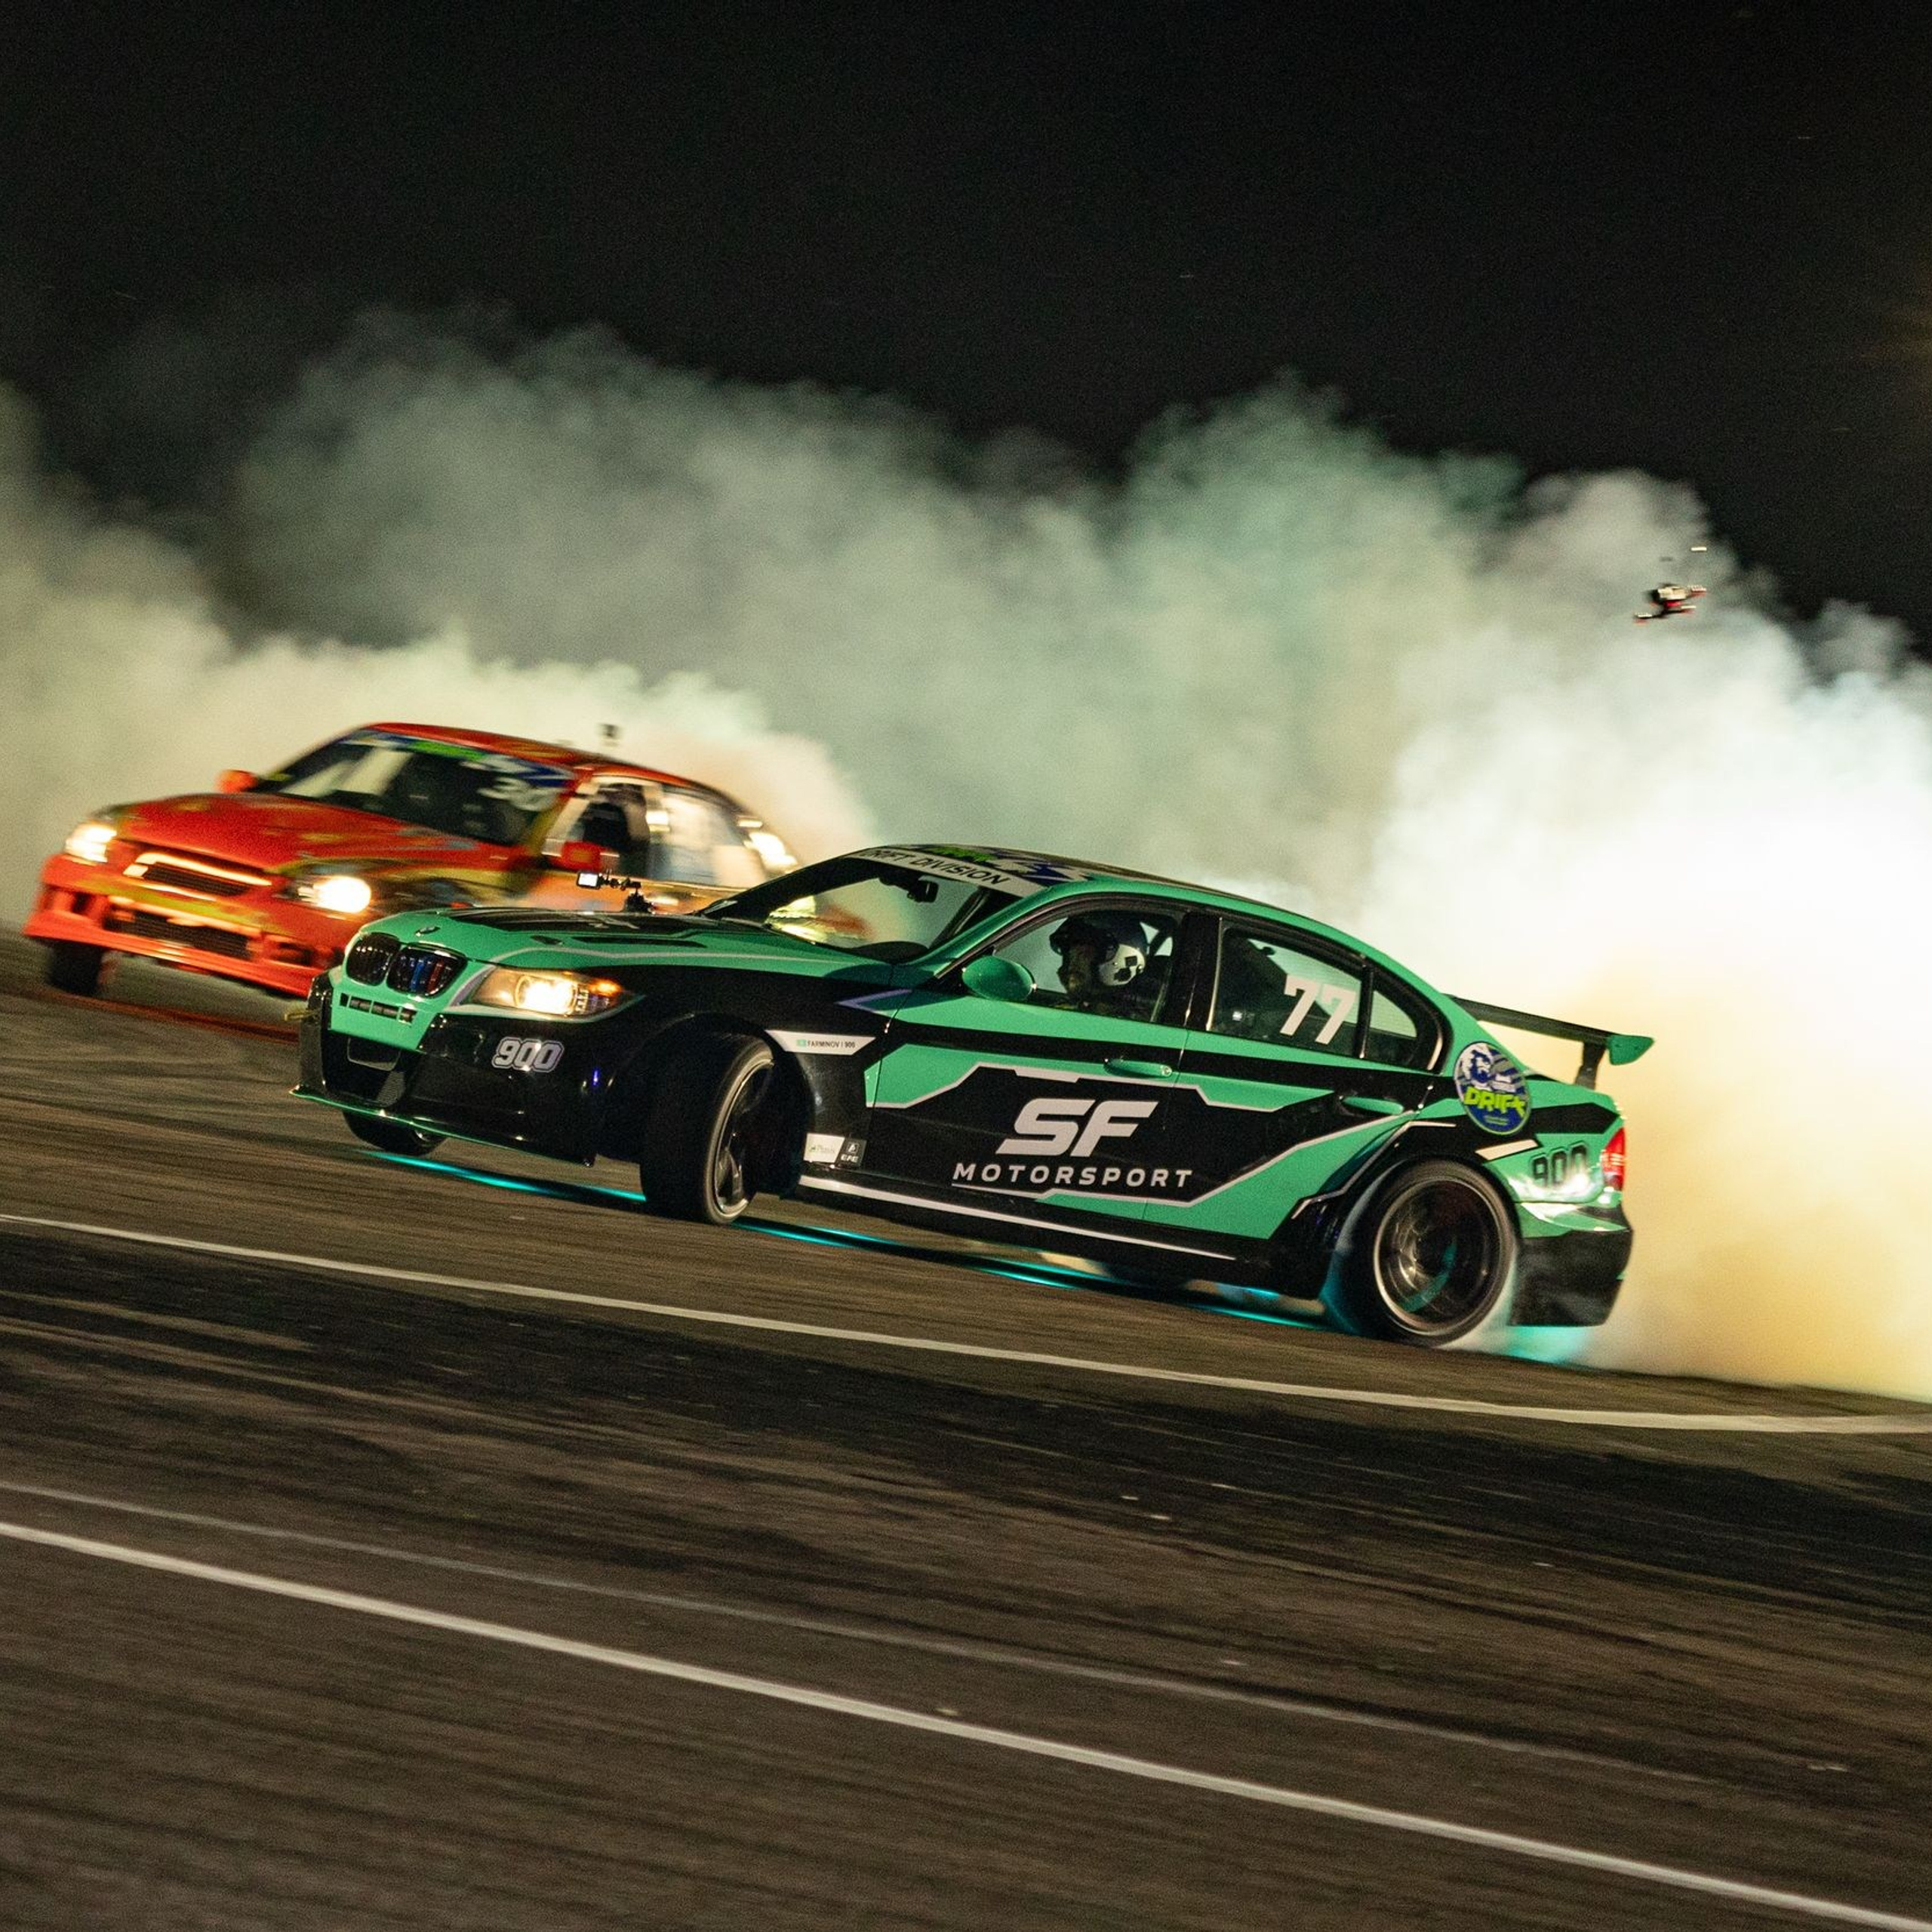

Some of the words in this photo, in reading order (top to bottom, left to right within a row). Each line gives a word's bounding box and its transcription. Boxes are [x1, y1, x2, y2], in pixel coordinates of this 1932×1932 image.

[909, 857, 1011, 885] DIVISION
[1280, 974, 1357, 1045] 77
[492, 1036, 565, 1072] 900
[995, 1098, 1158, 1157] SF
[952, 1162, 1192, 1187] MOTORSPORT
